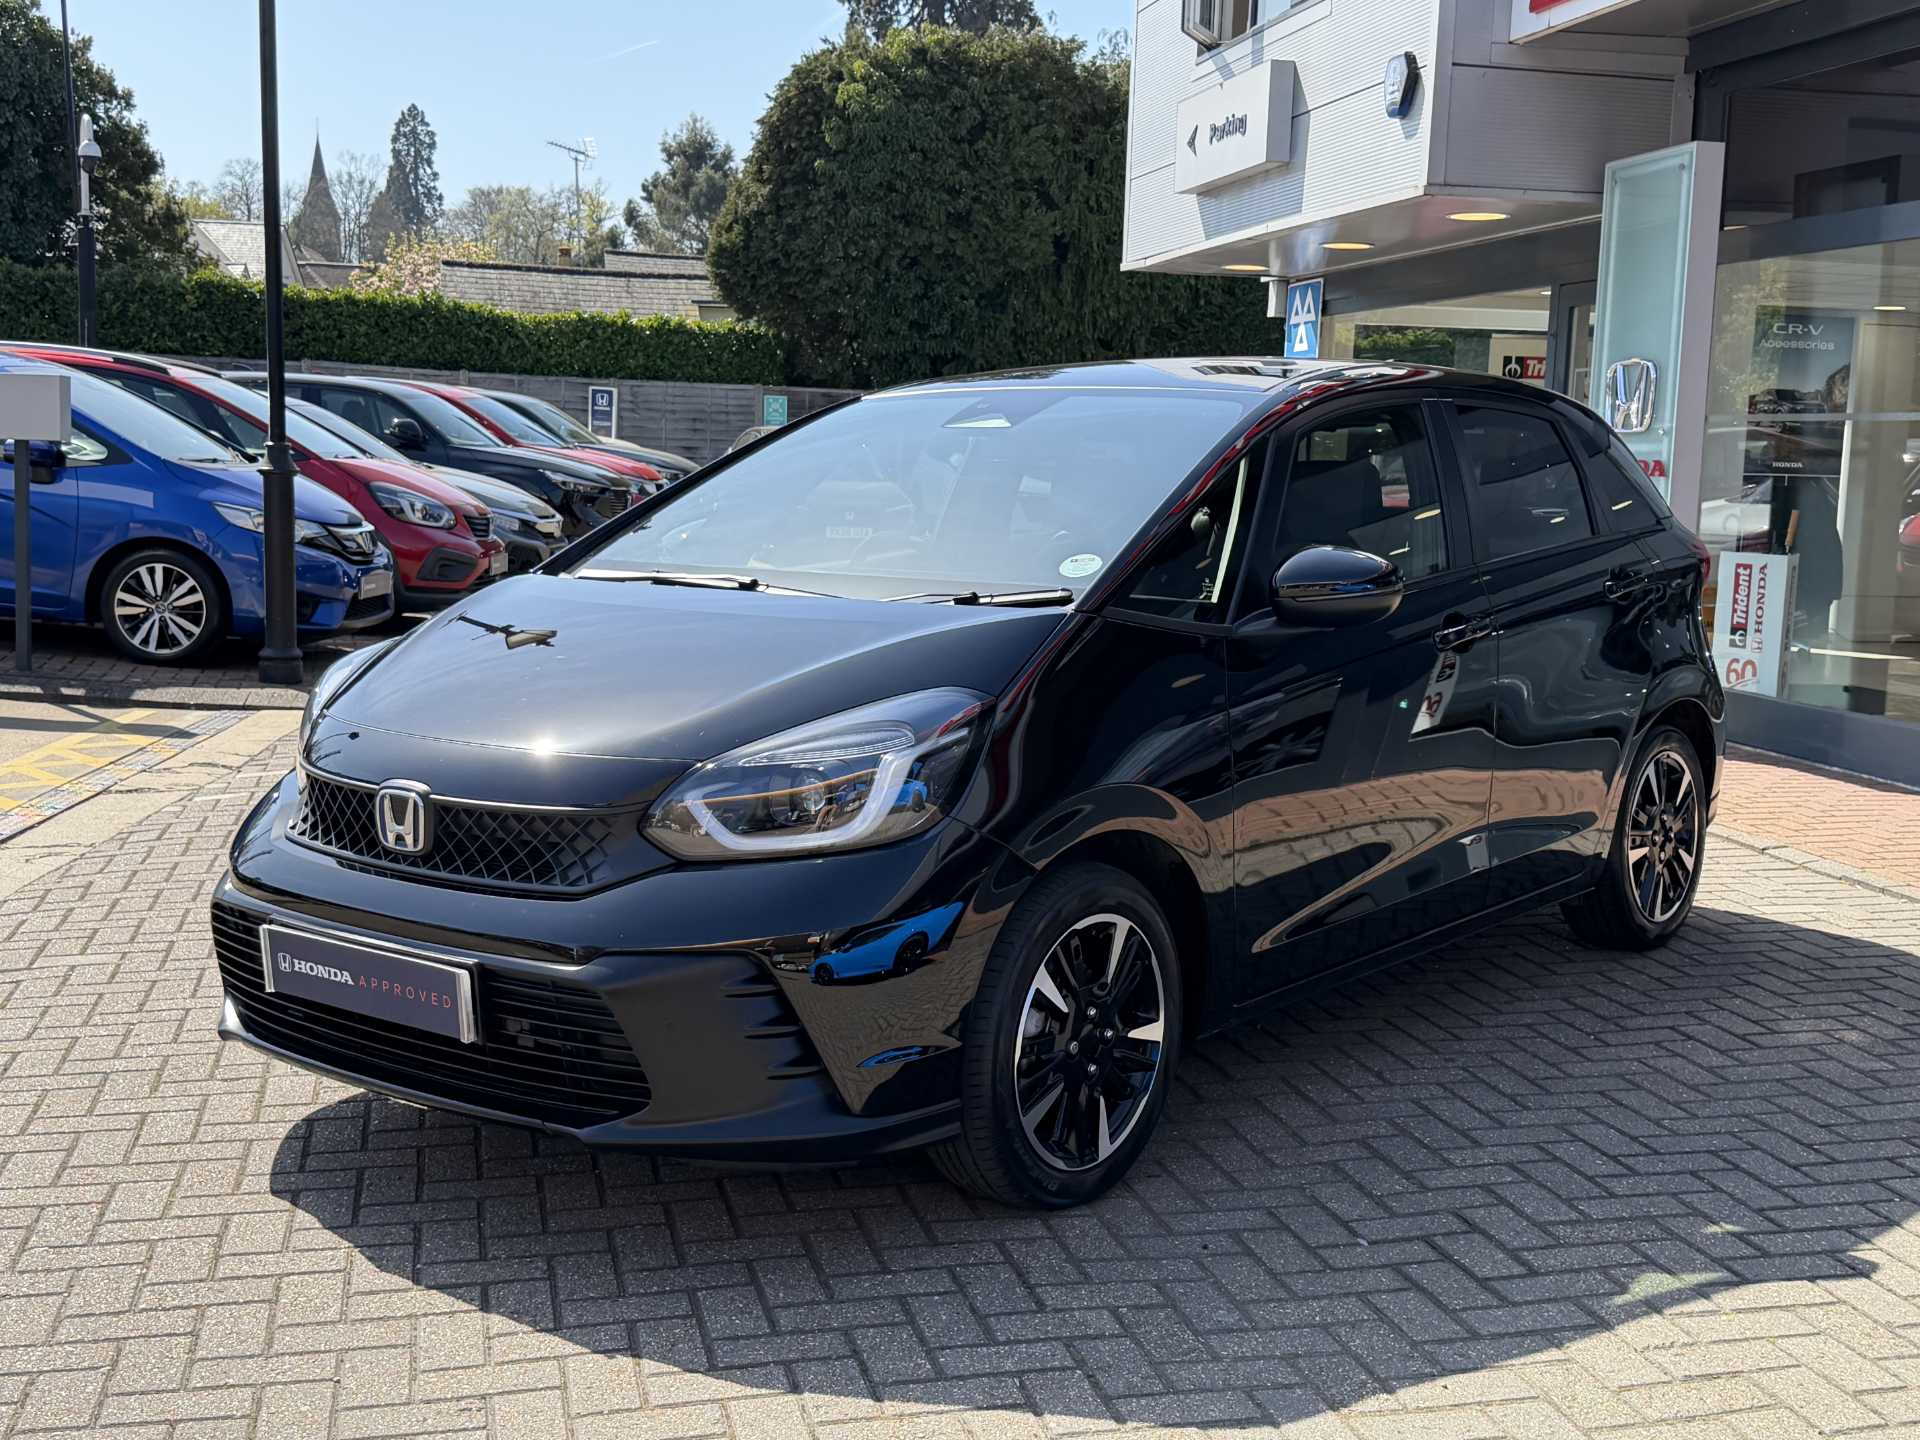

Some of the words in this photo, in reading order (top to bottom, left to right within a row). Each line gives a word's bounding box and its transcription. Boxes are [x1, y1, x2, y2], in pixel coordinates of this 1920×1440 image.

[1208, 113, 1247, 146] Parking
[1760, 338, 1835, 351] Accessories
[1772, 461, 1803, 469] HONDA
[1734, 566, 1750, 625] Trident
[1754, 563, 1768, 634] HONDA
[293, 959, 355, 985] HONDA
[359, 975, 454, 1008] APPROVED
